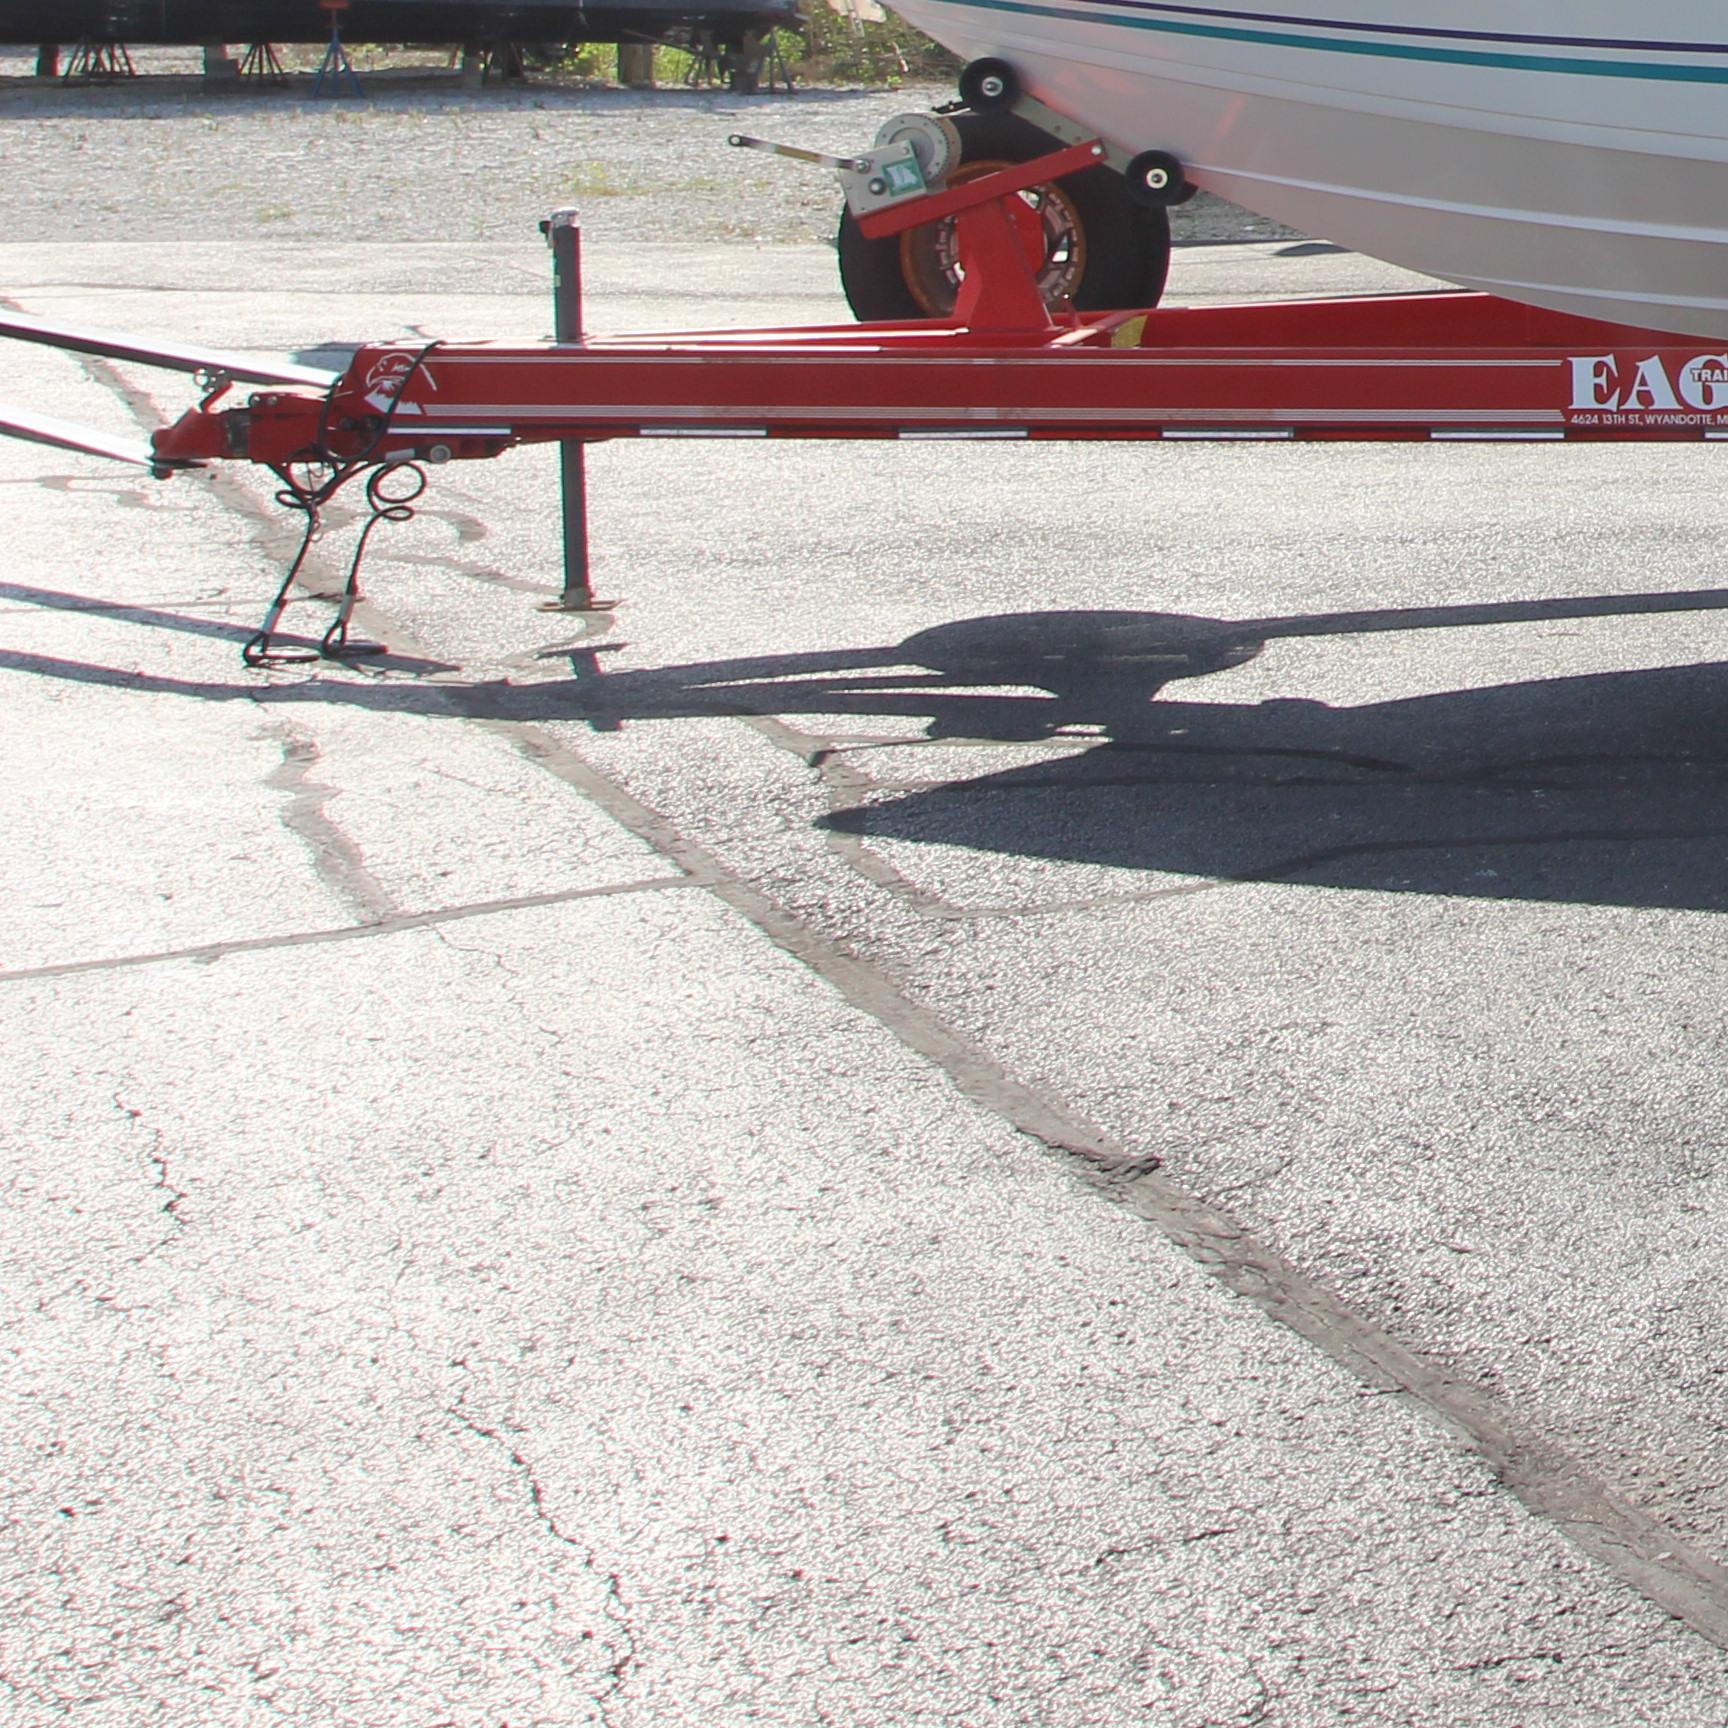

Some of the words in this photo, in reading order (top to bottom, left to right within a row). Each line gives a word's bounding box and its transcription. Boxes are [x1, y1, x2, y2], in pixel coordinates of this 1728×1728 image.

[1571, 413, 1599, 425] 4624
[1602, 413, 1626, 425] 13TH
[1644, 413, 1715, 426] WYANDOTTE,
